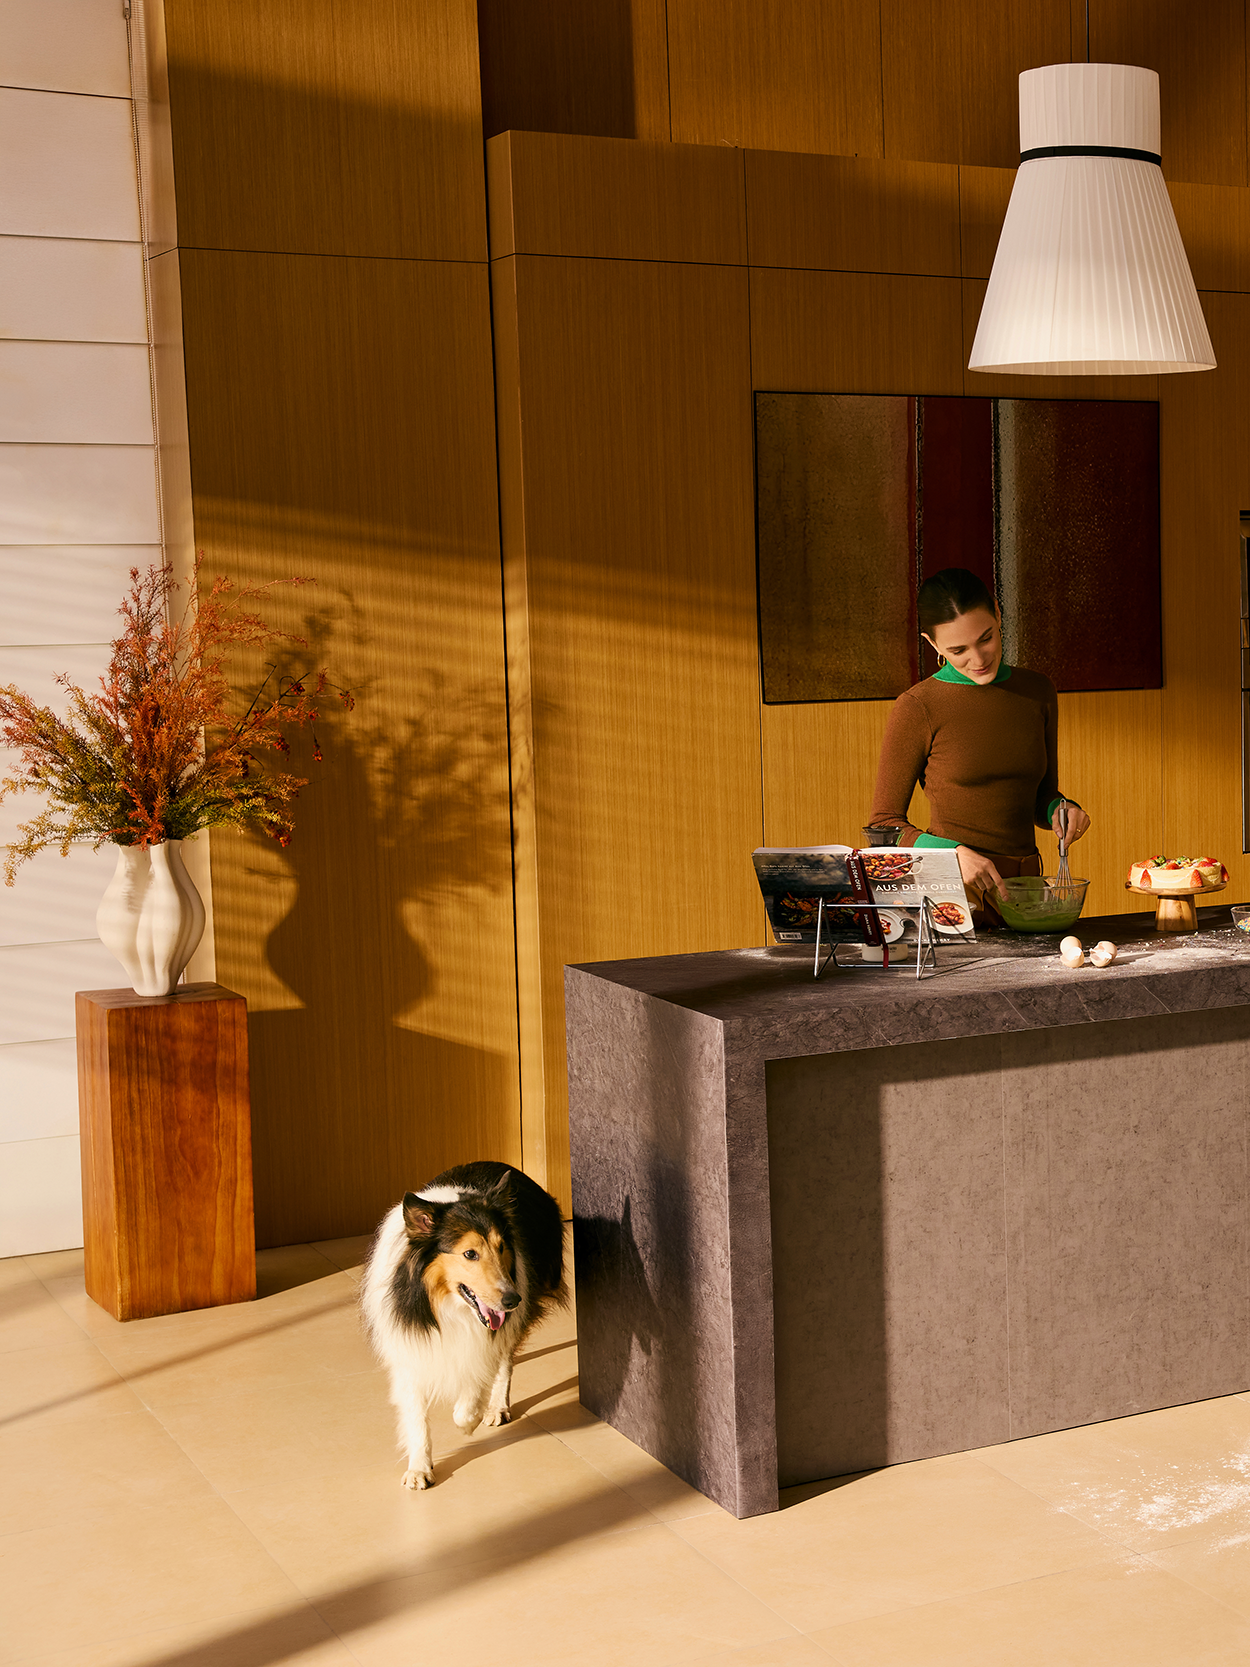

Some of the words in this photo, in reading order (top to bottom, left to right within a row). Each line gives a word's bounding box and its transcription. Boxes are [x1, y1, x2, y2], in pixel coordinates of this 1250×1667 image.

[875, 883, 898, 892] AUS
[901, 883, 927, 891] DEM
[930, 883, 962, 891] OFEN
